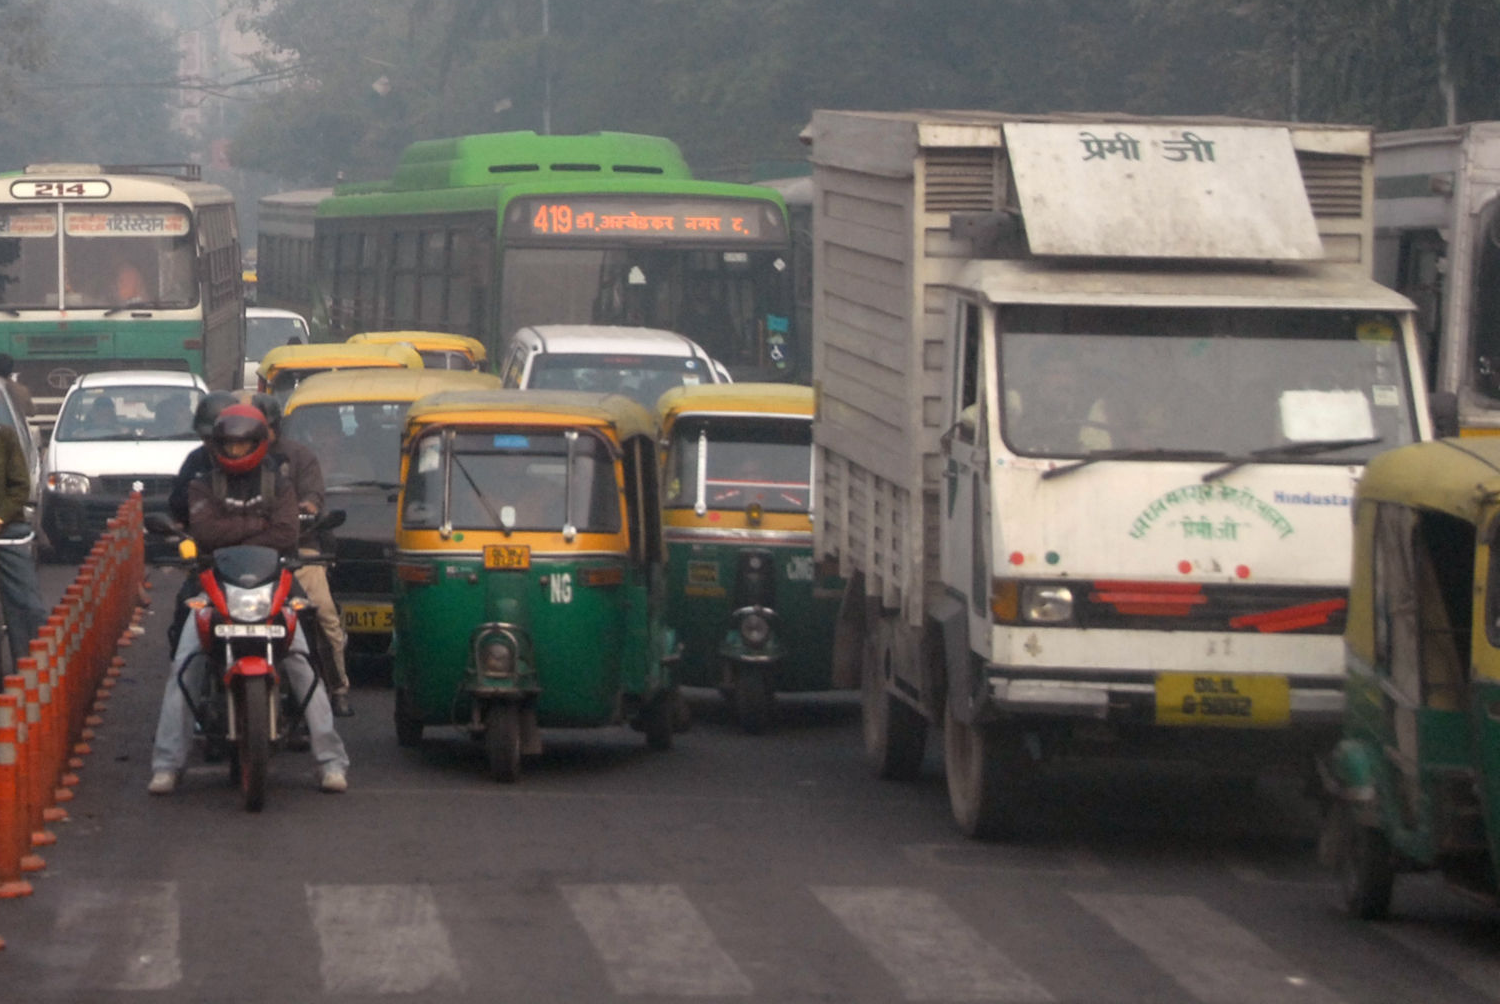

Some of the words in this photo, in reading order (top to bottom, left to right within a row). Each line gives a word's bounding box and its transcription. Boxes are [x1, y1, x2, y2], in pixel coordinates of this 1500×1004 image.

[1078, 131, 1141, 161] प्रेमी
[1161, 131, 1216, 163] जी
[35, 183, 86, 196] 214
[533, 204, 573, 234] 419
[684, 216, 722, 232] नगर
